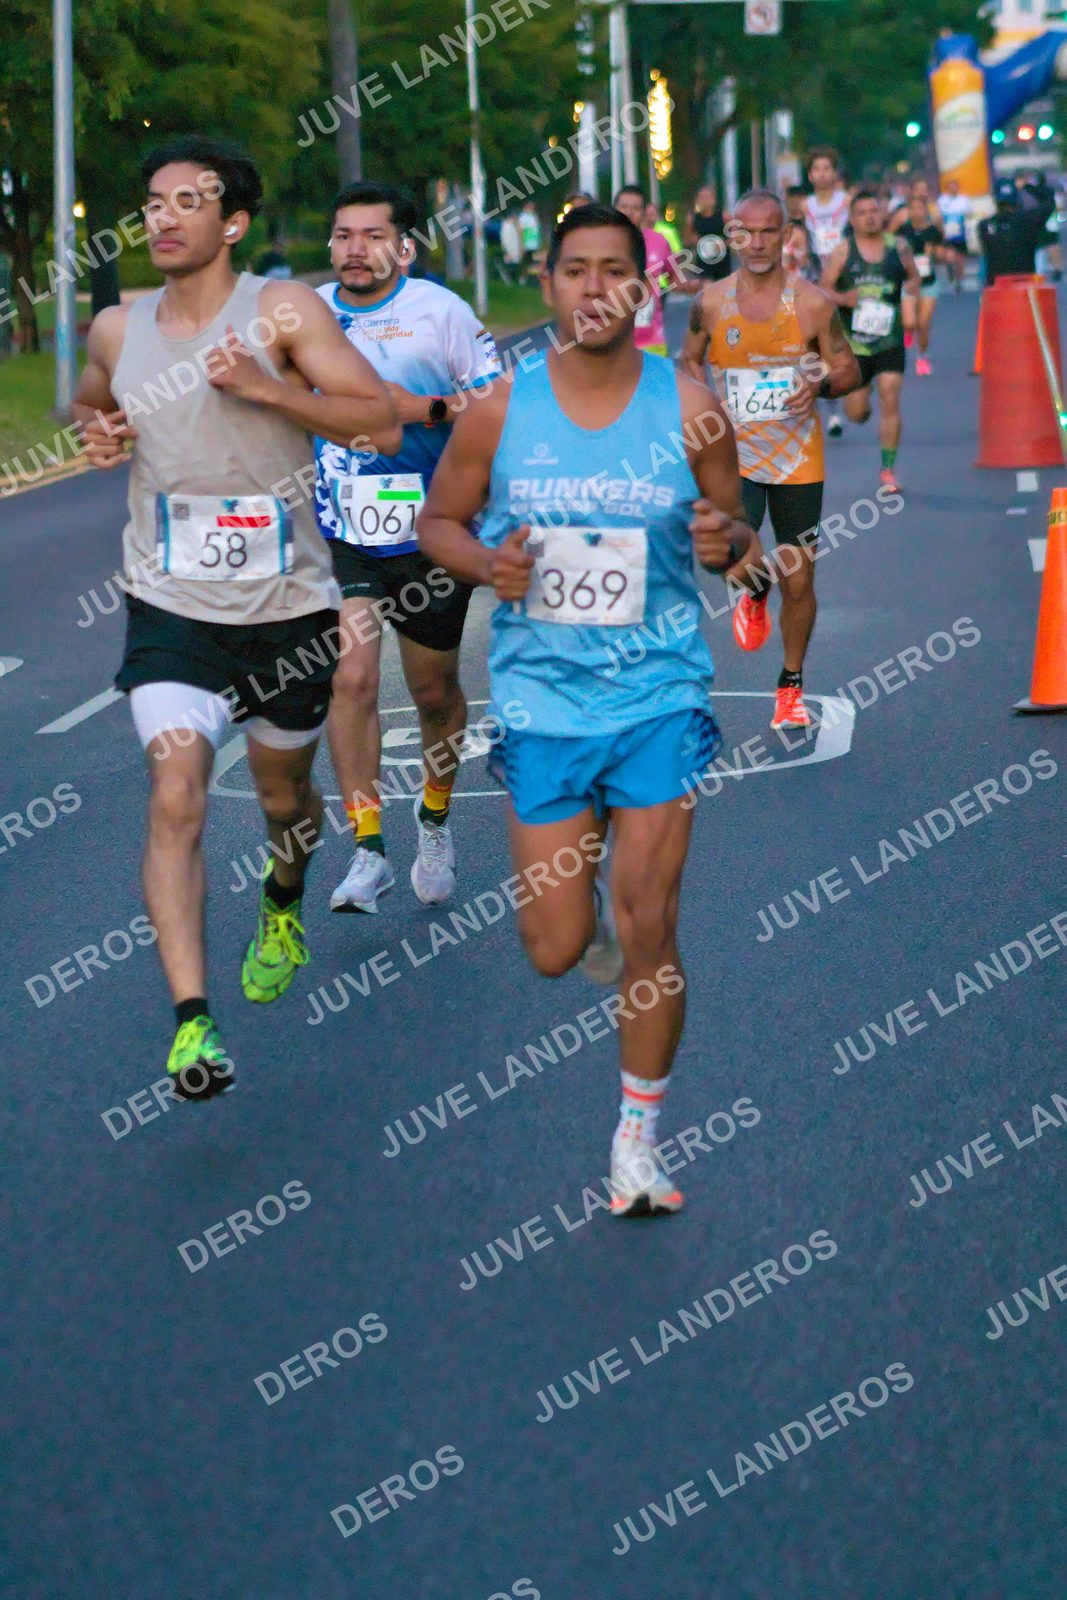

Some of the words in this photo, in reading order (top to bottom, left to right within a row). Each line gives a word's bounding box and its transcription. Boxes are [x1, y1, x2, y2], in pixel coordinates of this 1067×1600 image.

[344, 504, 416, 536] 1061
[200, 532, 247, 568] 58
[541, 568, 628, 611] 369
